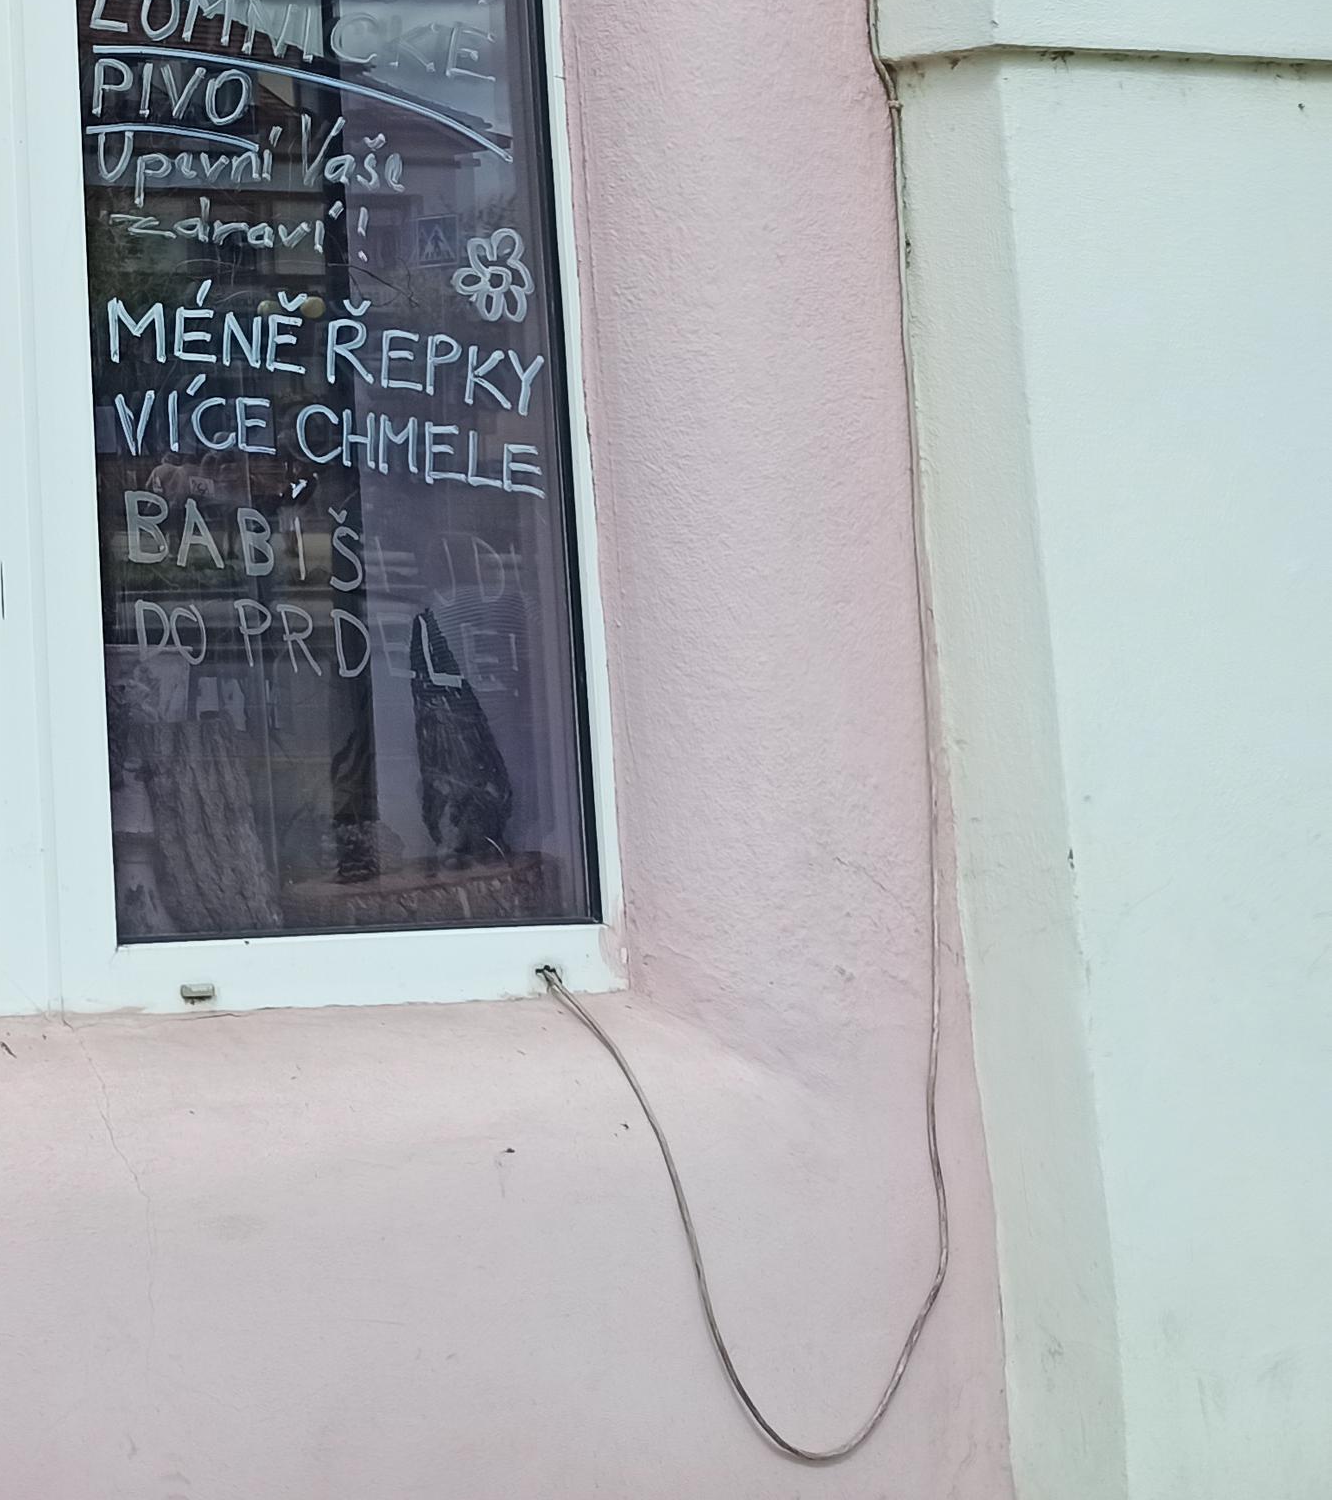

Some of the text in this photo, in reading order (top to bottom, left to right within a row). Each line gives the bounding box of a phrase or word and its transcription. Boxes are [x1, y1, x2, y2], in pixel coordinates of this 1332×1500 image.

[92, 58, 255, 126] PIVO
[300, 113, 406, 193] Vaše
[107, 279, 545, 417] MÉNĚ ŘEPKY
[113, 372, 547, 500] VÍCE CHMELE
[134, 599, 208, 666] DO
